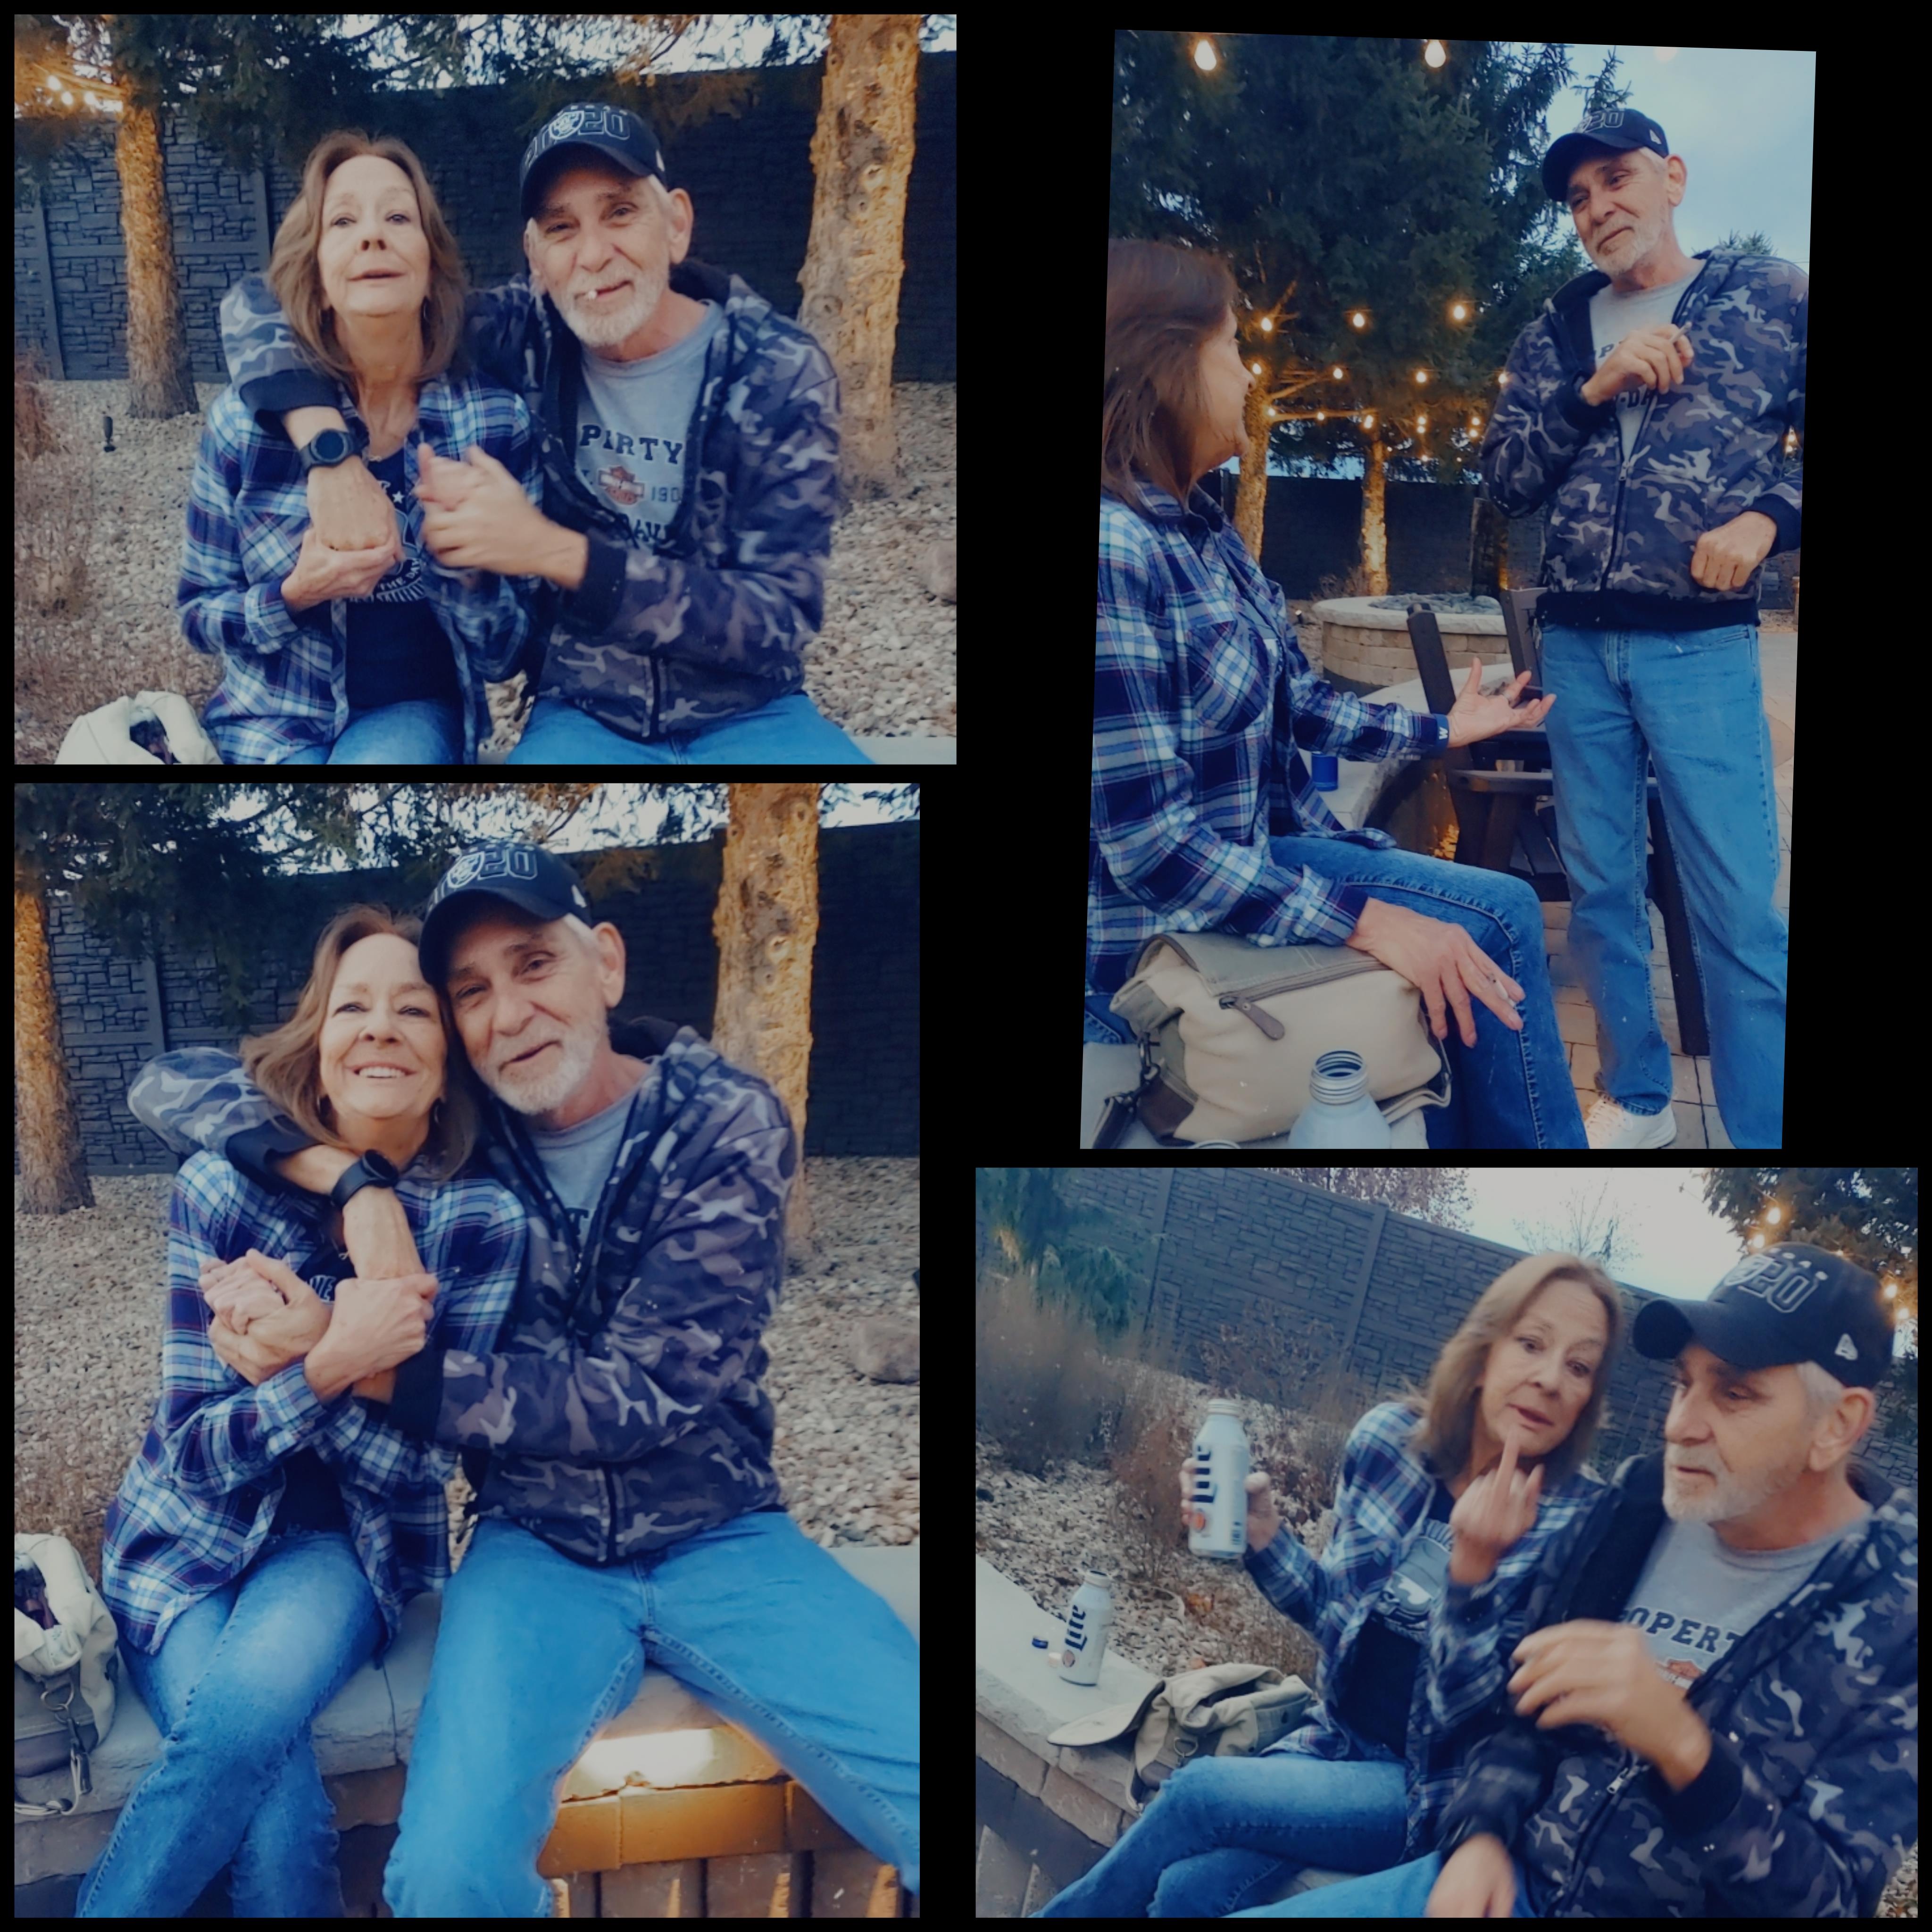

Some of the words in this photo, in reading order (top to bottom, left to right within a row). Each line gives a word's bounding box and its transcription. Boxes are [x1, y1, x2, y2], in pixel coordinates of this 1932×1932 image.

[1585, 108, 1625, 132] 20
[477, 847, 539, 881] 20
[1737, 1260, 1820, 1313] 20
